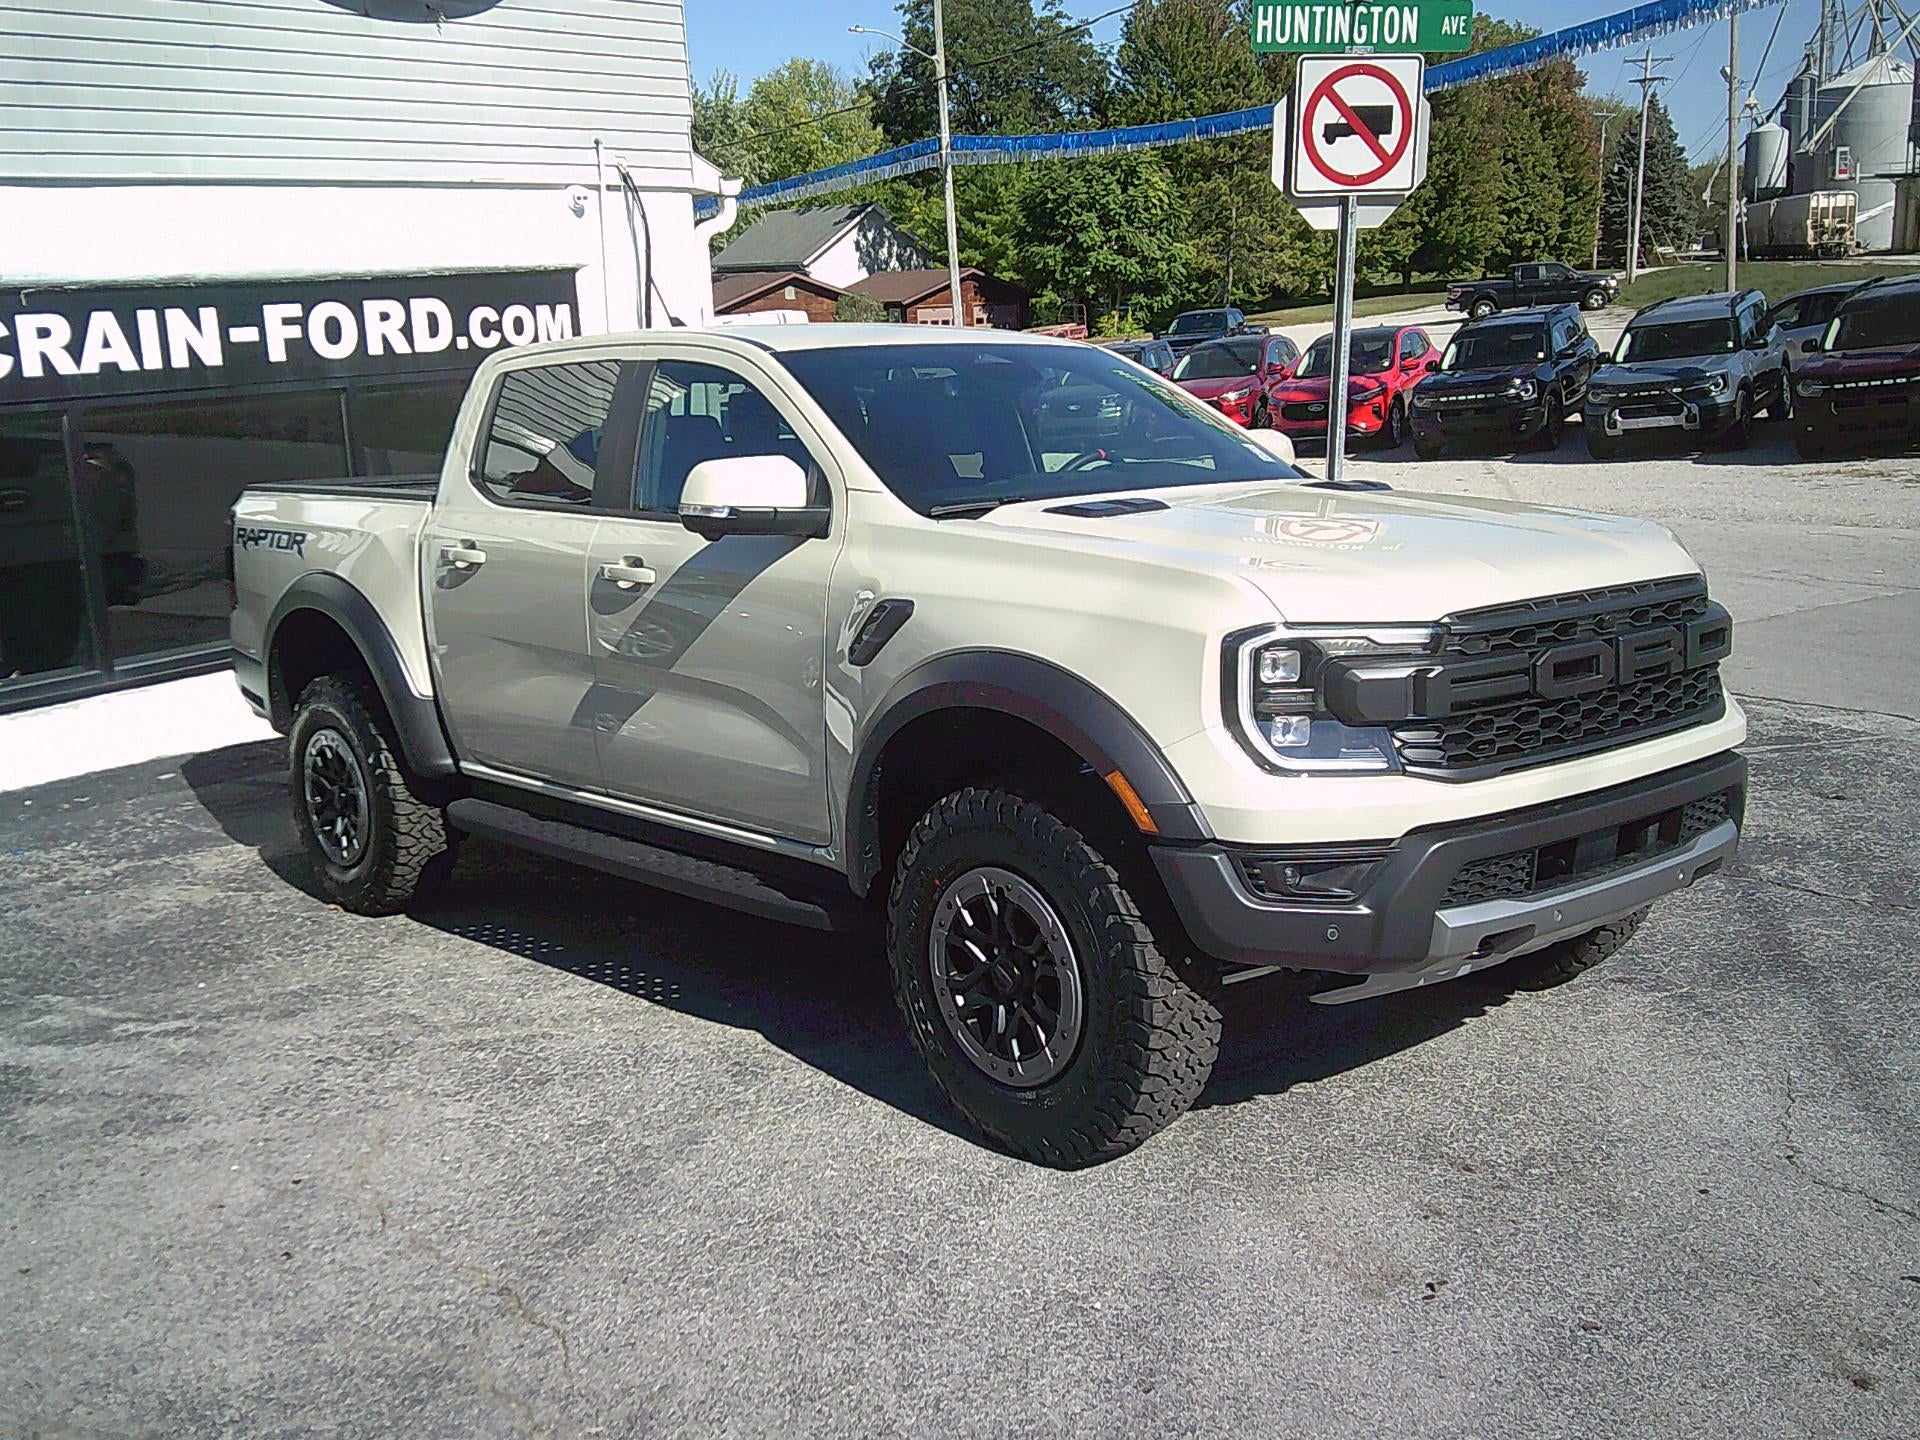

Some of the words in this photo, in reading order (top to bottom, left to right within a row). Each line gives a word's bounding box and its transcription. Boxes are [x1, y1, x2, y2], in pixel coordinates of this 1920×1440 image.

[1256, 5, 1419, 44] HUNTINGTON
[1441, 16, 1468, 36] AVE
[0, 297, 573, 379] RAIN-FORD.COM
[236, 526, 305, 560] RAPTOR
[1426, 599, 1734, 720] FORD
